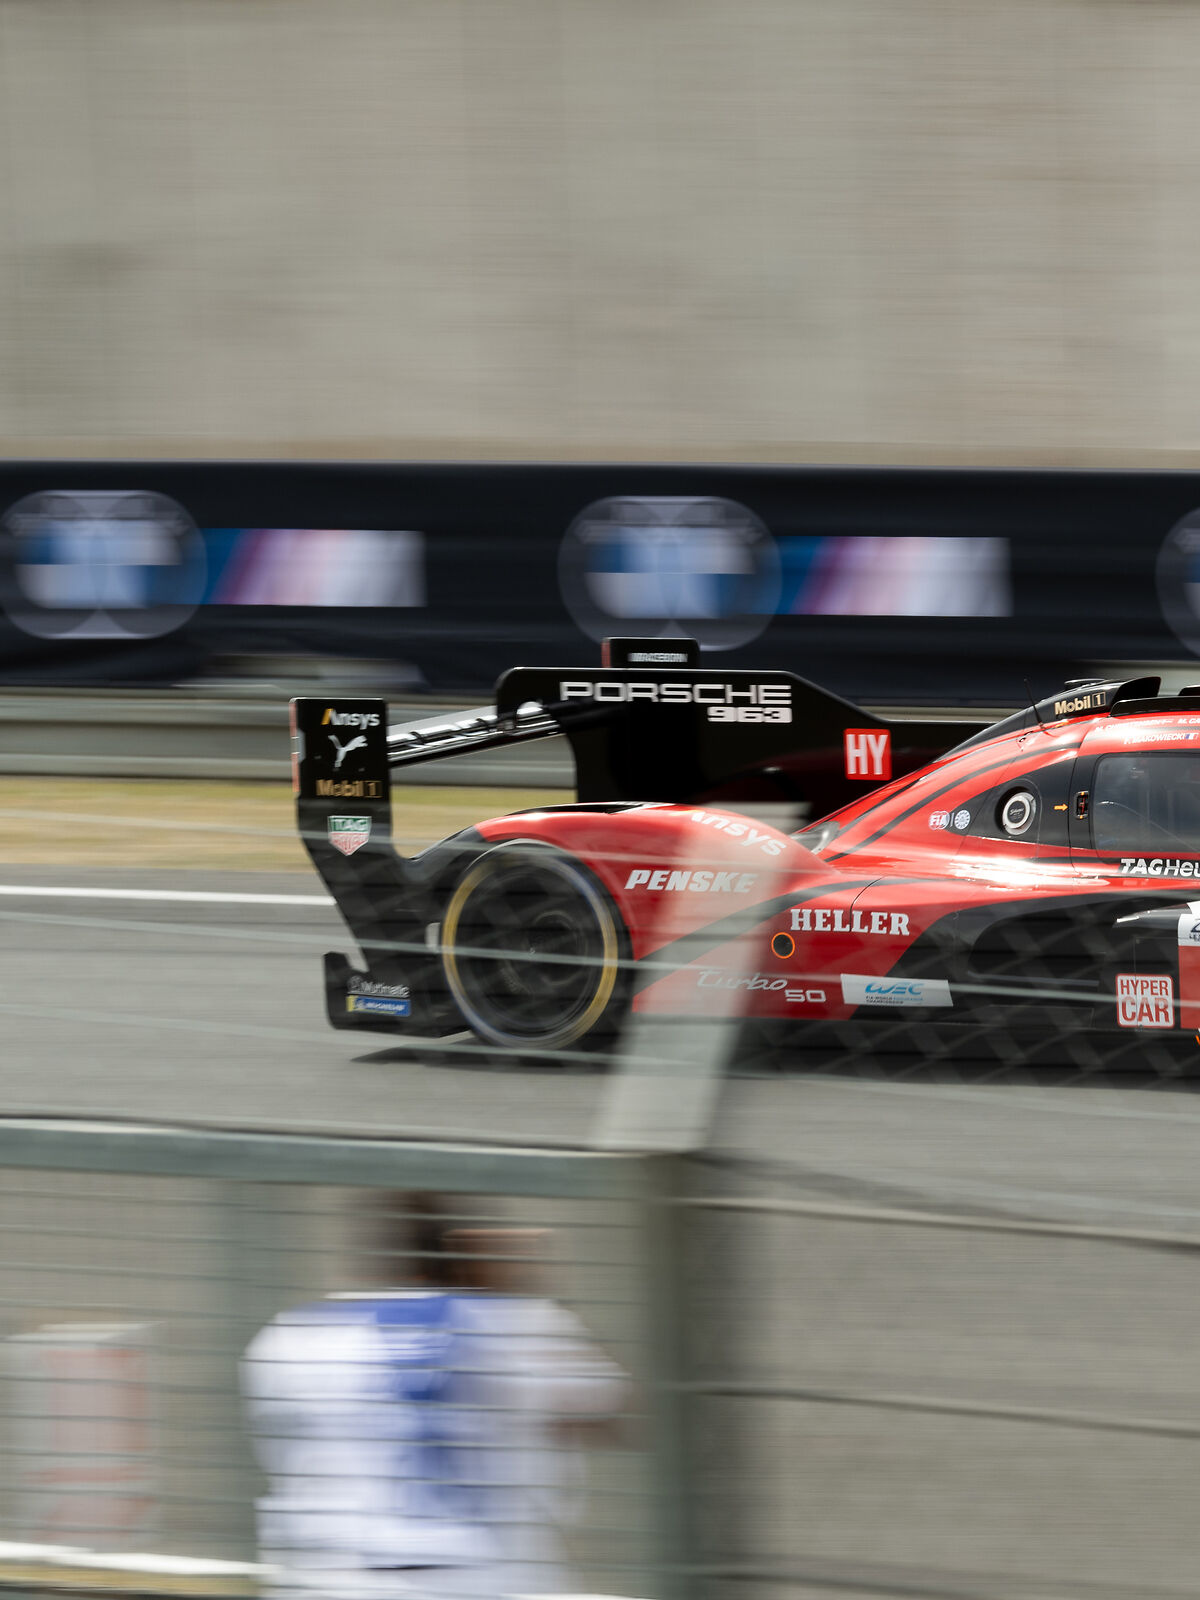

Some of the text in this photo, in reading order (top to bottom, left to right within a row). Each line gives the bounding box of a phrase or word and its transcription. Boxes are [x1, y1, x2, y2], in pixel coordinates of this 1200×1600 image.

[560, 681, 792, 705] PORSCHE
[707, 706, 792, 723] 963
[1054, 695, 1091, 715] Mobil
[321, 708, 380, 730] Ansys
[845, 734, 889, 775] HY
[316, 779, 364, 797] Mobil
[929, 814, 949, 827] FIA
[624, 869, 757, 893] PENSKE
[790, 908, 910, 936] HELLER
[697, 969, 788, 990] Turbo
[864, 981, 924, 996] WEC
[1120, 979, 1169, 996] HYPER
[784, 989, 827, 1003] 50
[1121, 997, 1170, 1023] CAR
